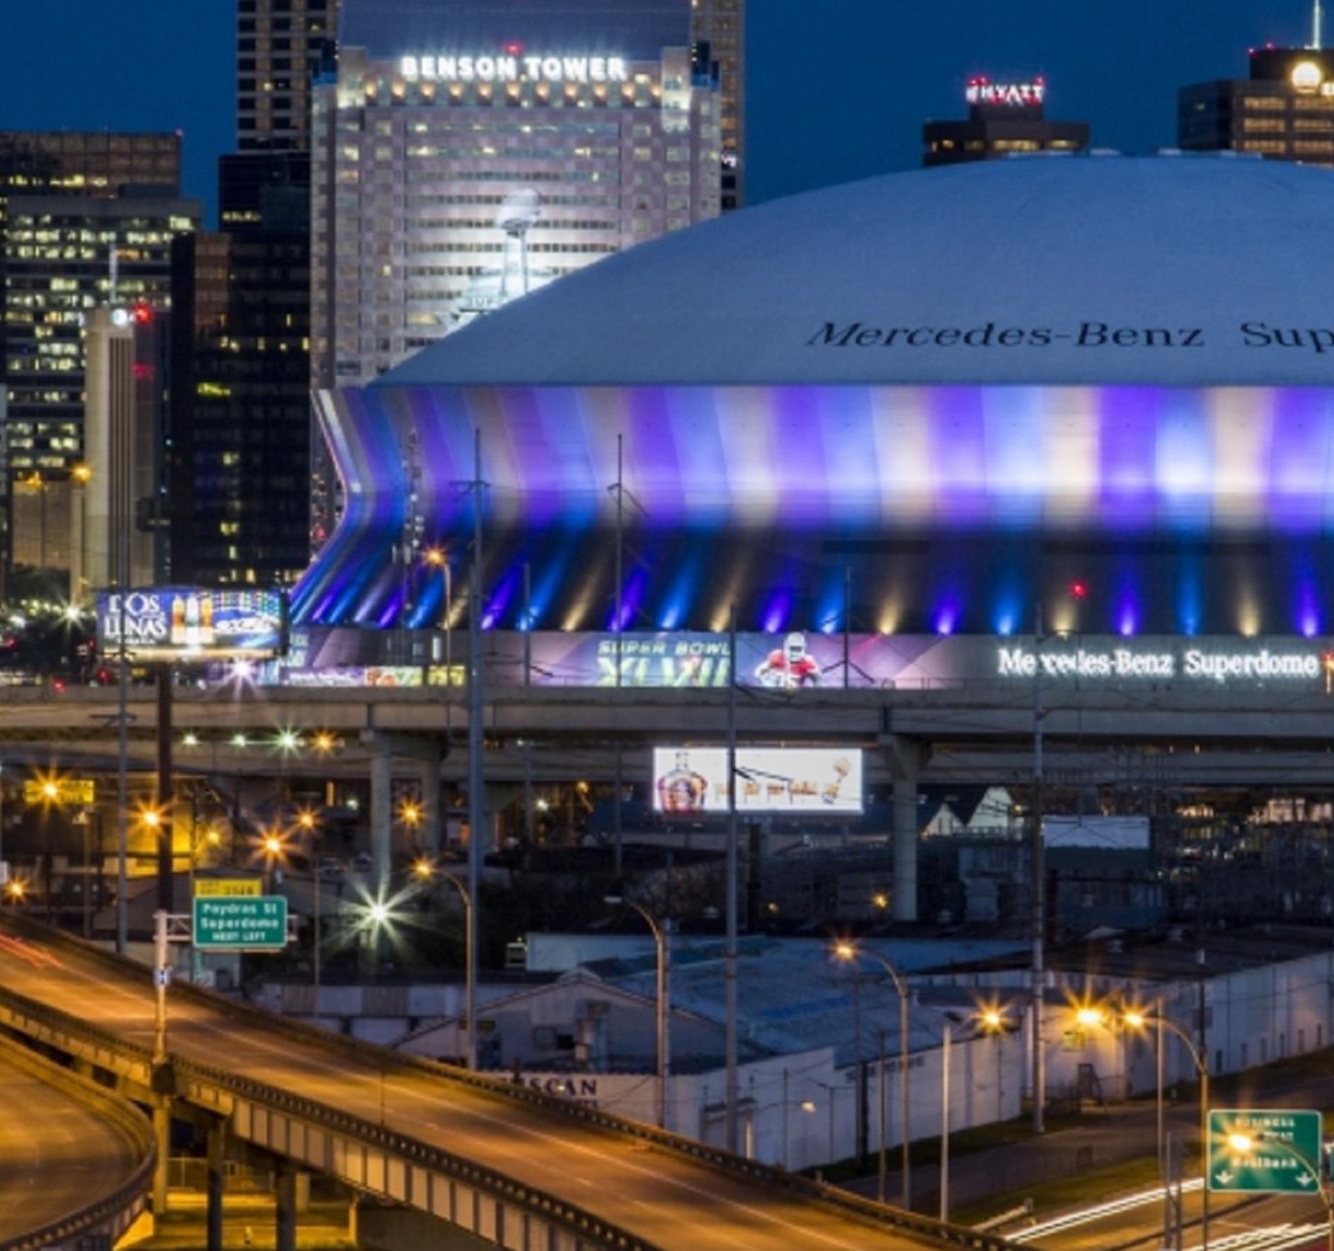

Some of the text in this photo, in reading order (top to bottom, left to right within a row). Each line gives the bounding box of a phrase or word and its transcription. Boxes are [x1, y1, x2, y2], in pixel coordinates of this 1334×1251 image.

[400, 55, 627, 82] BENSON TOWER
[980, 84, 1043, 105] HYATT
[807, 320, 1205, 348] Mercedes-Benz
[598, 640, 731, 656] SUPER BOWL
[1184, 649, 1319, 680] Superdome
[202, 902, 257, 916] Poydras
[201, 917, 279, 930] Superdome
